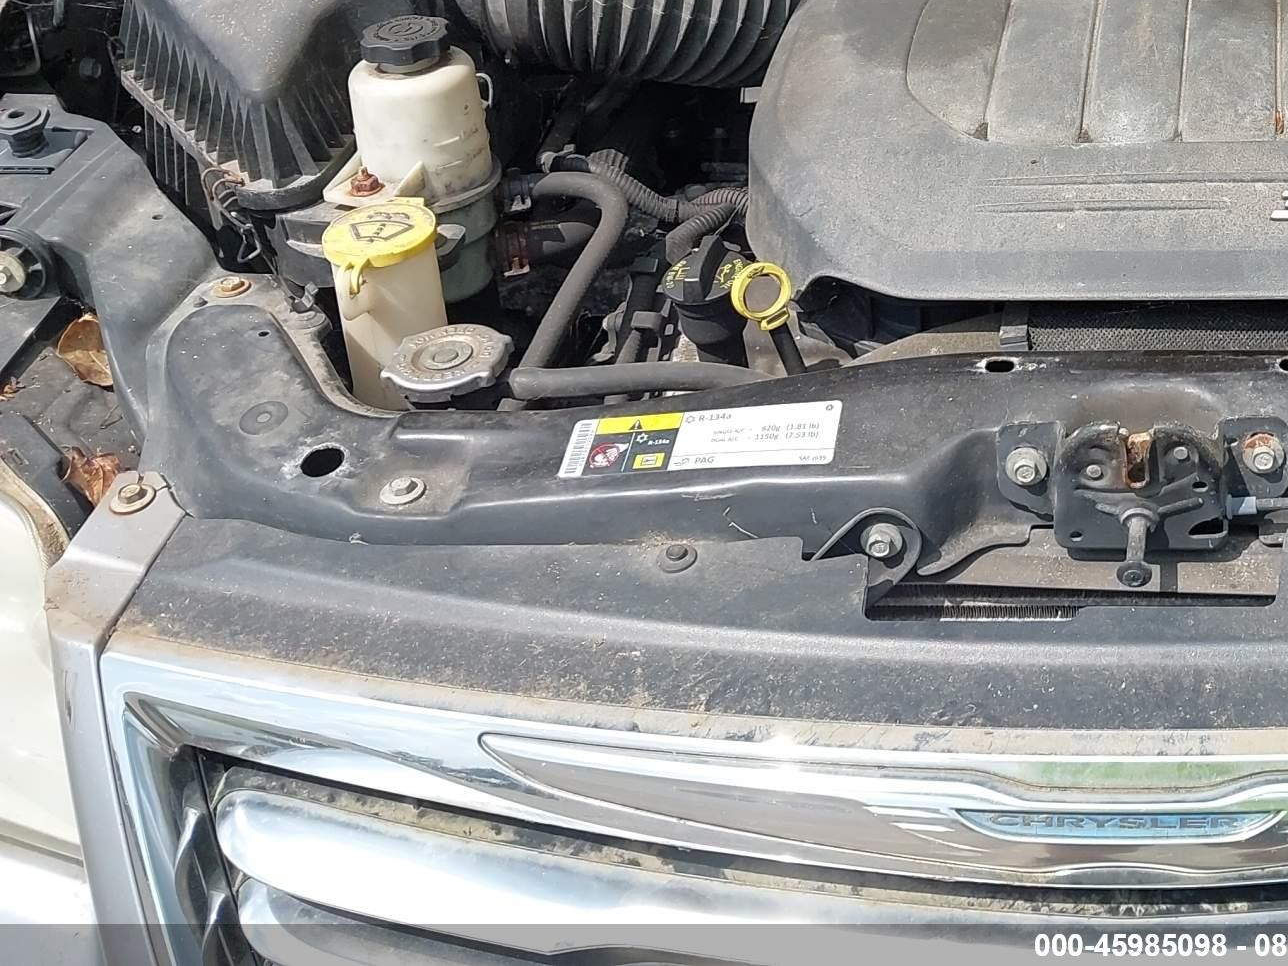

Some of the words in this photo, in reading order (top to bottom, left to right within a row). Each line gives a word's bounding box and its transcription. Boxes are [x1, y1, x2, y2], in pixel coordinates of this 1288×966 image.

[698, 413, 732, 422] R-134a
[694, 456, 715, 464] PAG
[989, 814, 1242, 830] CHRYSLER
